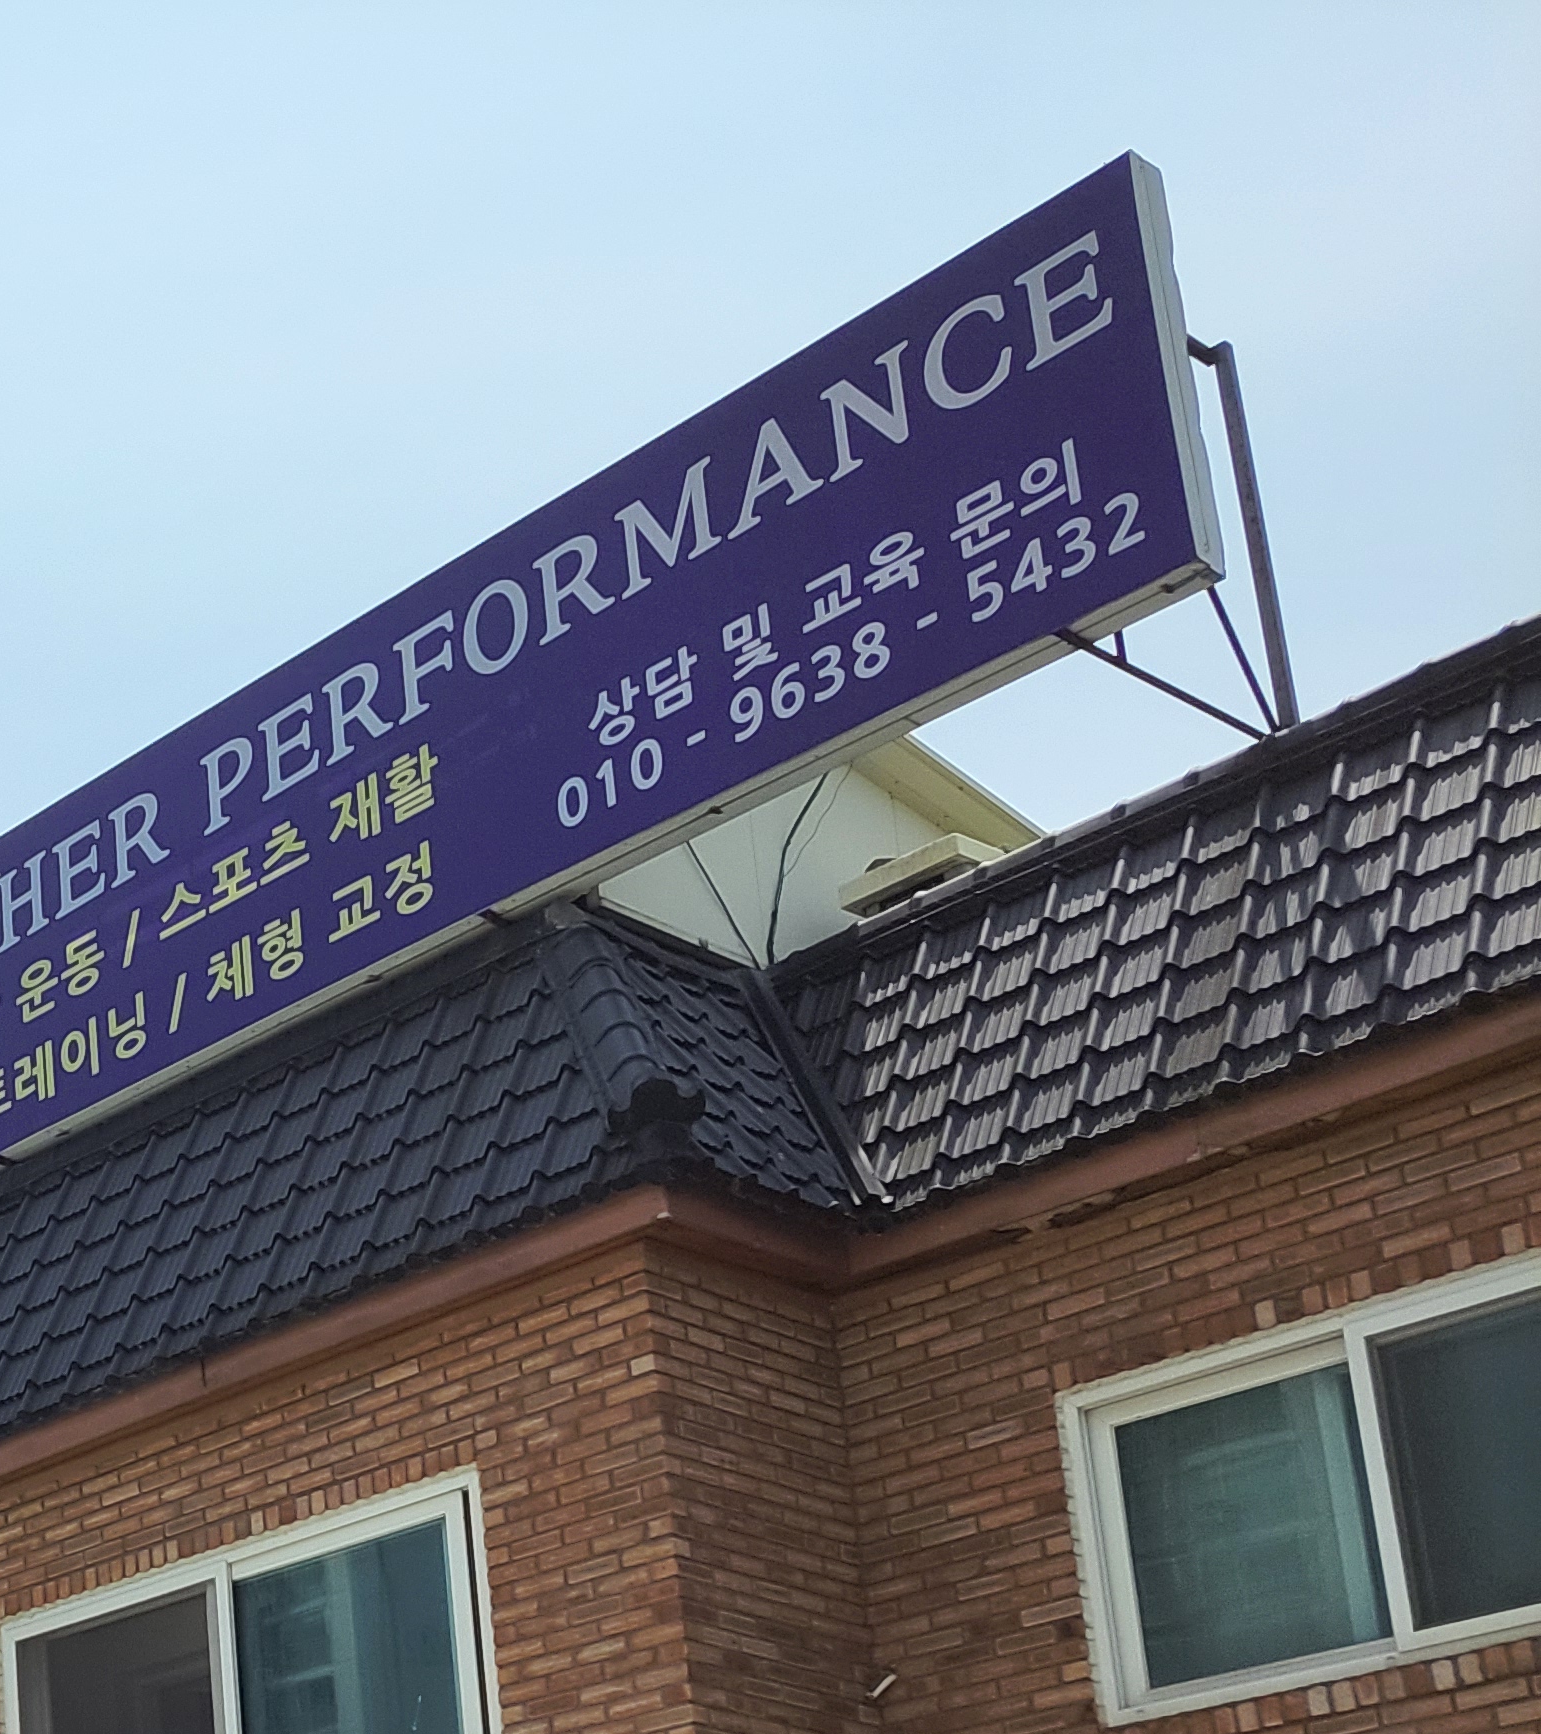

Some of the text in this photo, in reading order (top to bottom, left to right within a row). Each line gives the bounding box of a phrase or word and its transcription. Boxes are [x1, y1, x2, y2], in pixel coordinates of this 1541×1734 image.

[200, 230, 1113, 836] PERFORMANCE
[557, 738, 663, 828] 010
[729, 621, 891, 743] 9638
[966, 492, 1146, 623] 5432
[587, 438, 1082, 746] 상담 및 교육 문의
[15, 929, 105, 1024] 운동
[158, 820, 310, 941] 스포츠
[328, 743, 439, 843] 재활
[206, 907, 304, 1002] 체형
[328, 839, 435, 944] 교정
